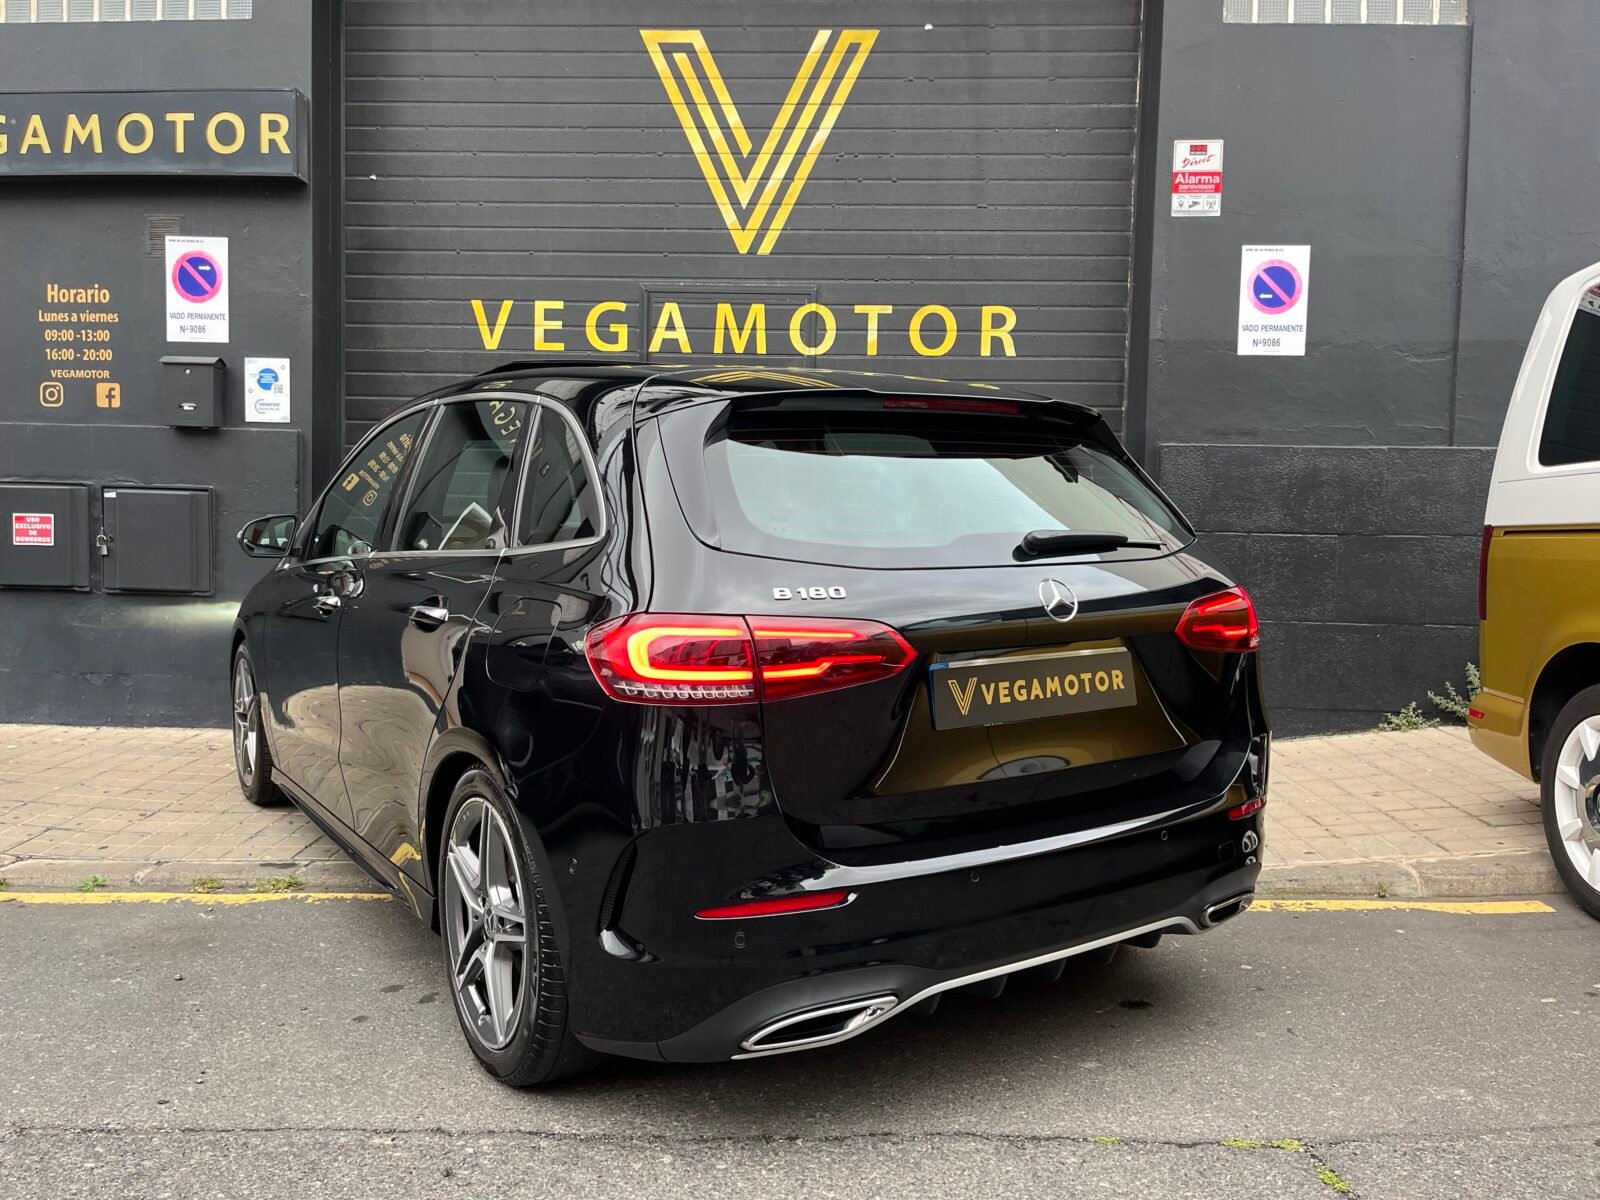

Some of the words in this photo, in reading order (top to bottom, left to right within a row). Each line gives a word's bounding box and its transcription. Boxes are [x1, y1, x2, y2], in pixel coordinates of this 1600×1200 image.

[0, 112, 291, 155] AMOTOR
[1181, 154, 1216, 169] Direct
[1174, 173, 1220, 184] Alarma
[47, 283, 110, 303] Horario
[38, 309, 69, 322] Lunes
[71, 313, 78, 322] a
[80, 310, 119, 323] viernes
[169, 312, 185, 320] VADO
[187, 312, 226, 321] PERMANENTE
[44, 329, 74, 341] 09:00
[471, 299, 1018, 358] VEGAMOTOR
[1242, 324, 1259, 333] VADO
[1261, 324, 1304, 333] PERMANENTE
[45, 348, 74, 360] 16:00
[82, 348, 113, 361] 20:00
[51, 369, 110, 379] VEGAMOTOR
[773, 587, 793, 600] B
[796, 586, 847, 600] 180
[981, 669, 1125, 705] VEGAMOTOR
